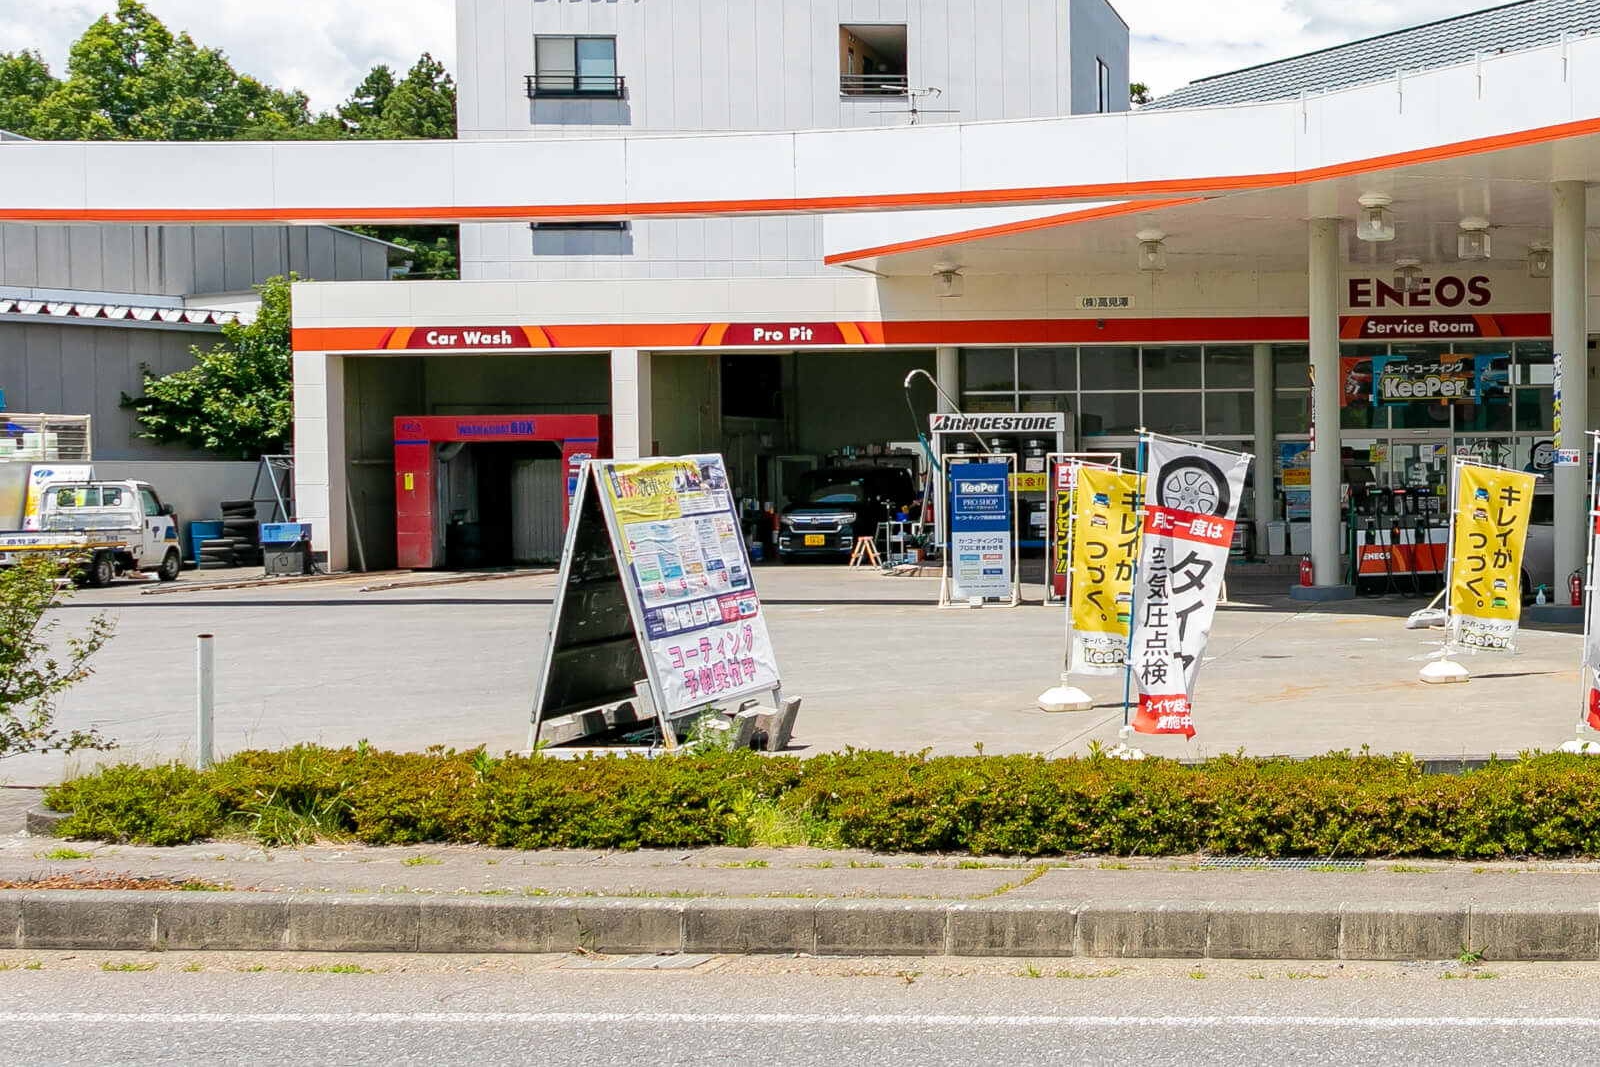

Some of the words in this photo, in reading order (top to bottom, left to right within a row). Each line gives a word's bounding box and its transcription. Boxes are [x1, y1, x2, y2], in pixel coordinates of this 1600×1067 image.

[1349, 276, 1491, 307] ENEOS
[753, 327, 784, 342] Pro
[789, 326, 813, 341] Pit
[1367, 320, 1424, 333] Service
[1429, 320, 1474, 333] Room
[426, 331, 457, 345] Car
[463, 330, 512, 345] Wash
[1384, 363, 1463, 374] キーパーコーティング
[1383, 376, 1467, 400] KeePer
[932, 415, 1057, 431] BRIDGESTONE
[960, 482, 999, 494] KeePer
[1152, 511, 1224, 540] 月に一度は
[1492, 485, 1521, 570] キレイが
[1466, 532, 1488, 609] つづく。
[1085, 541, 1108, 622] つづく。
[668, 624, 754, 669] コーティング
[1459, 628, 1510, 649] KeePer
[1084, 646, 1127, 664] KeeP
[1156, 714, 1193, 730] 実施中
